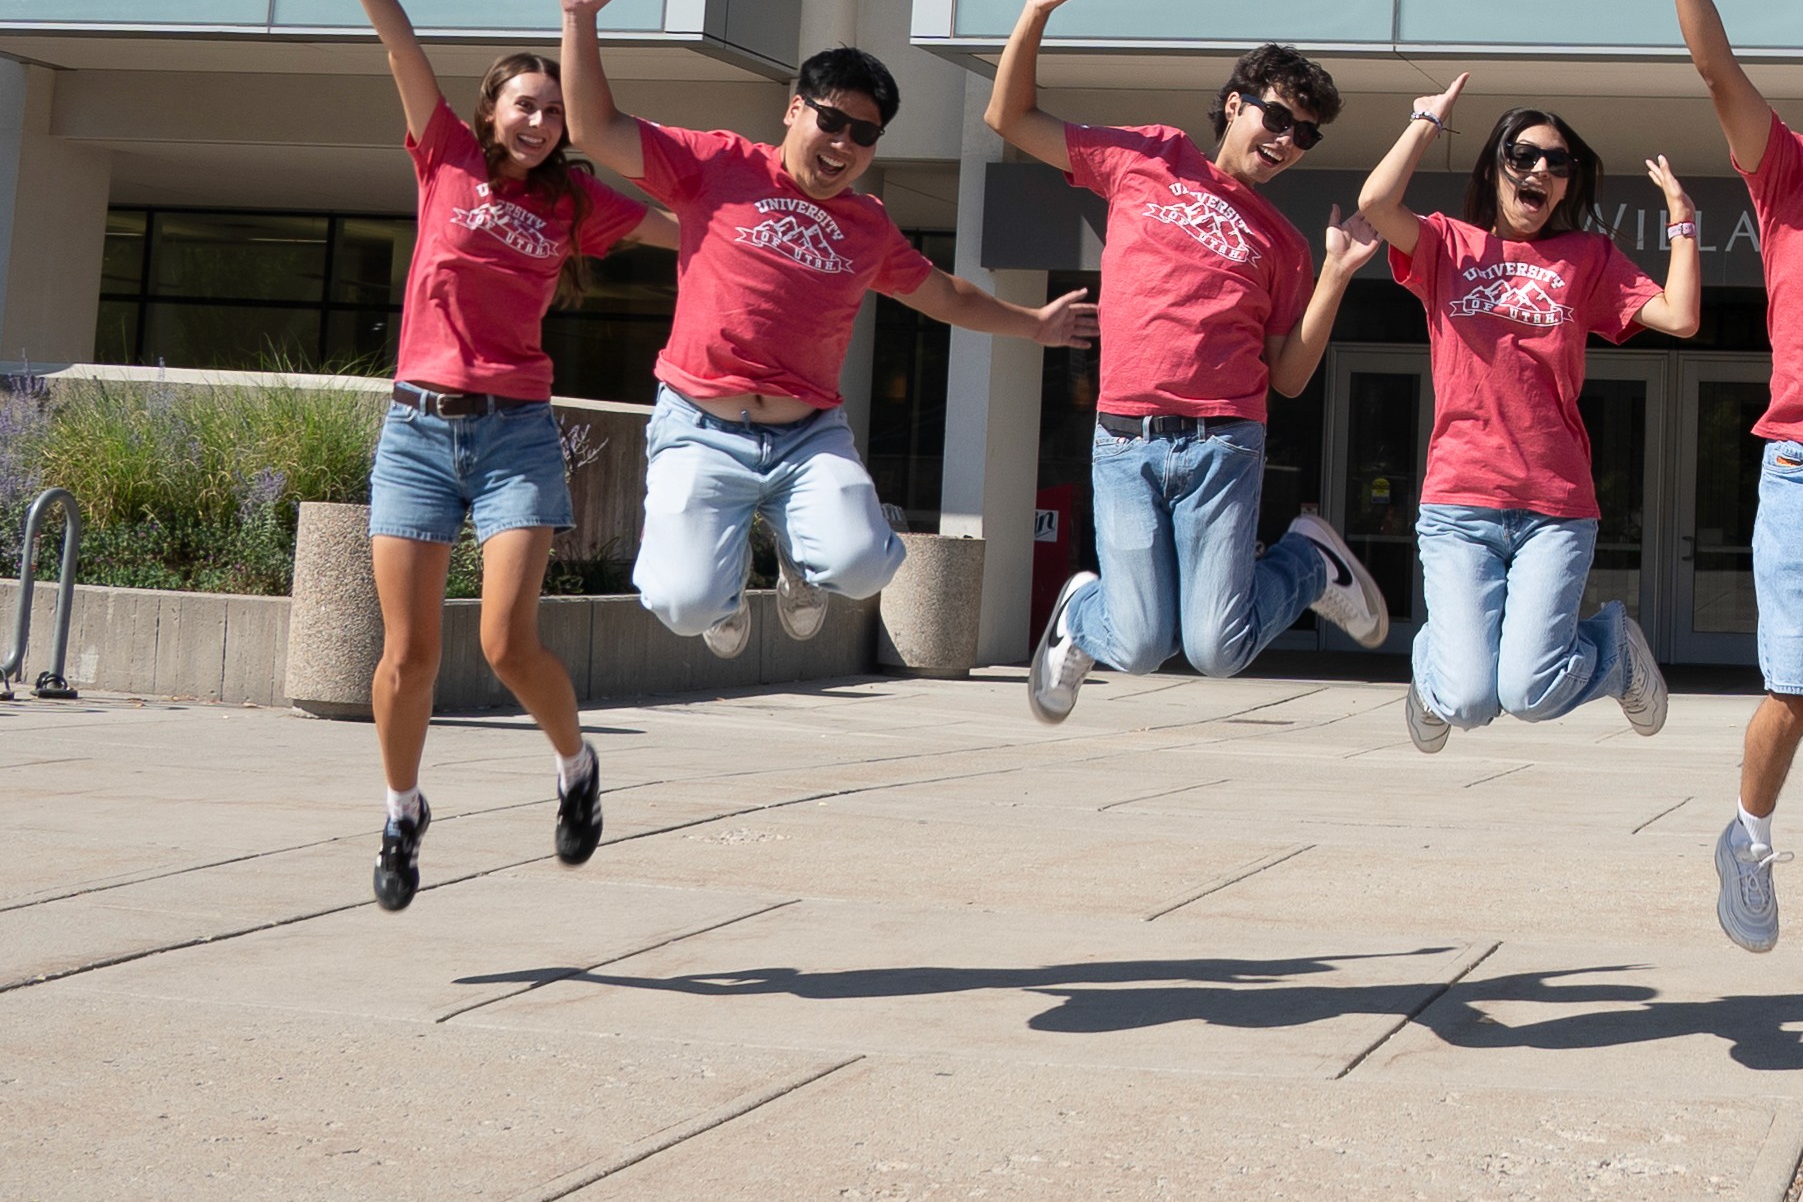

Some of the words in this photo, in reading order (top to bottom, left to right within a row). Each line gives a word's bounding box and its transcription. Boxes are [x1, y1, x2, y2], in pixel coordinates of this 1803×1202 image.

[754, 197, 845, 240] UNIVERSITY
[1583, 203, 1763, 252] WILLA
[761, 230, 781, 247] OF
[1471, 299, 1494, 312] OF
